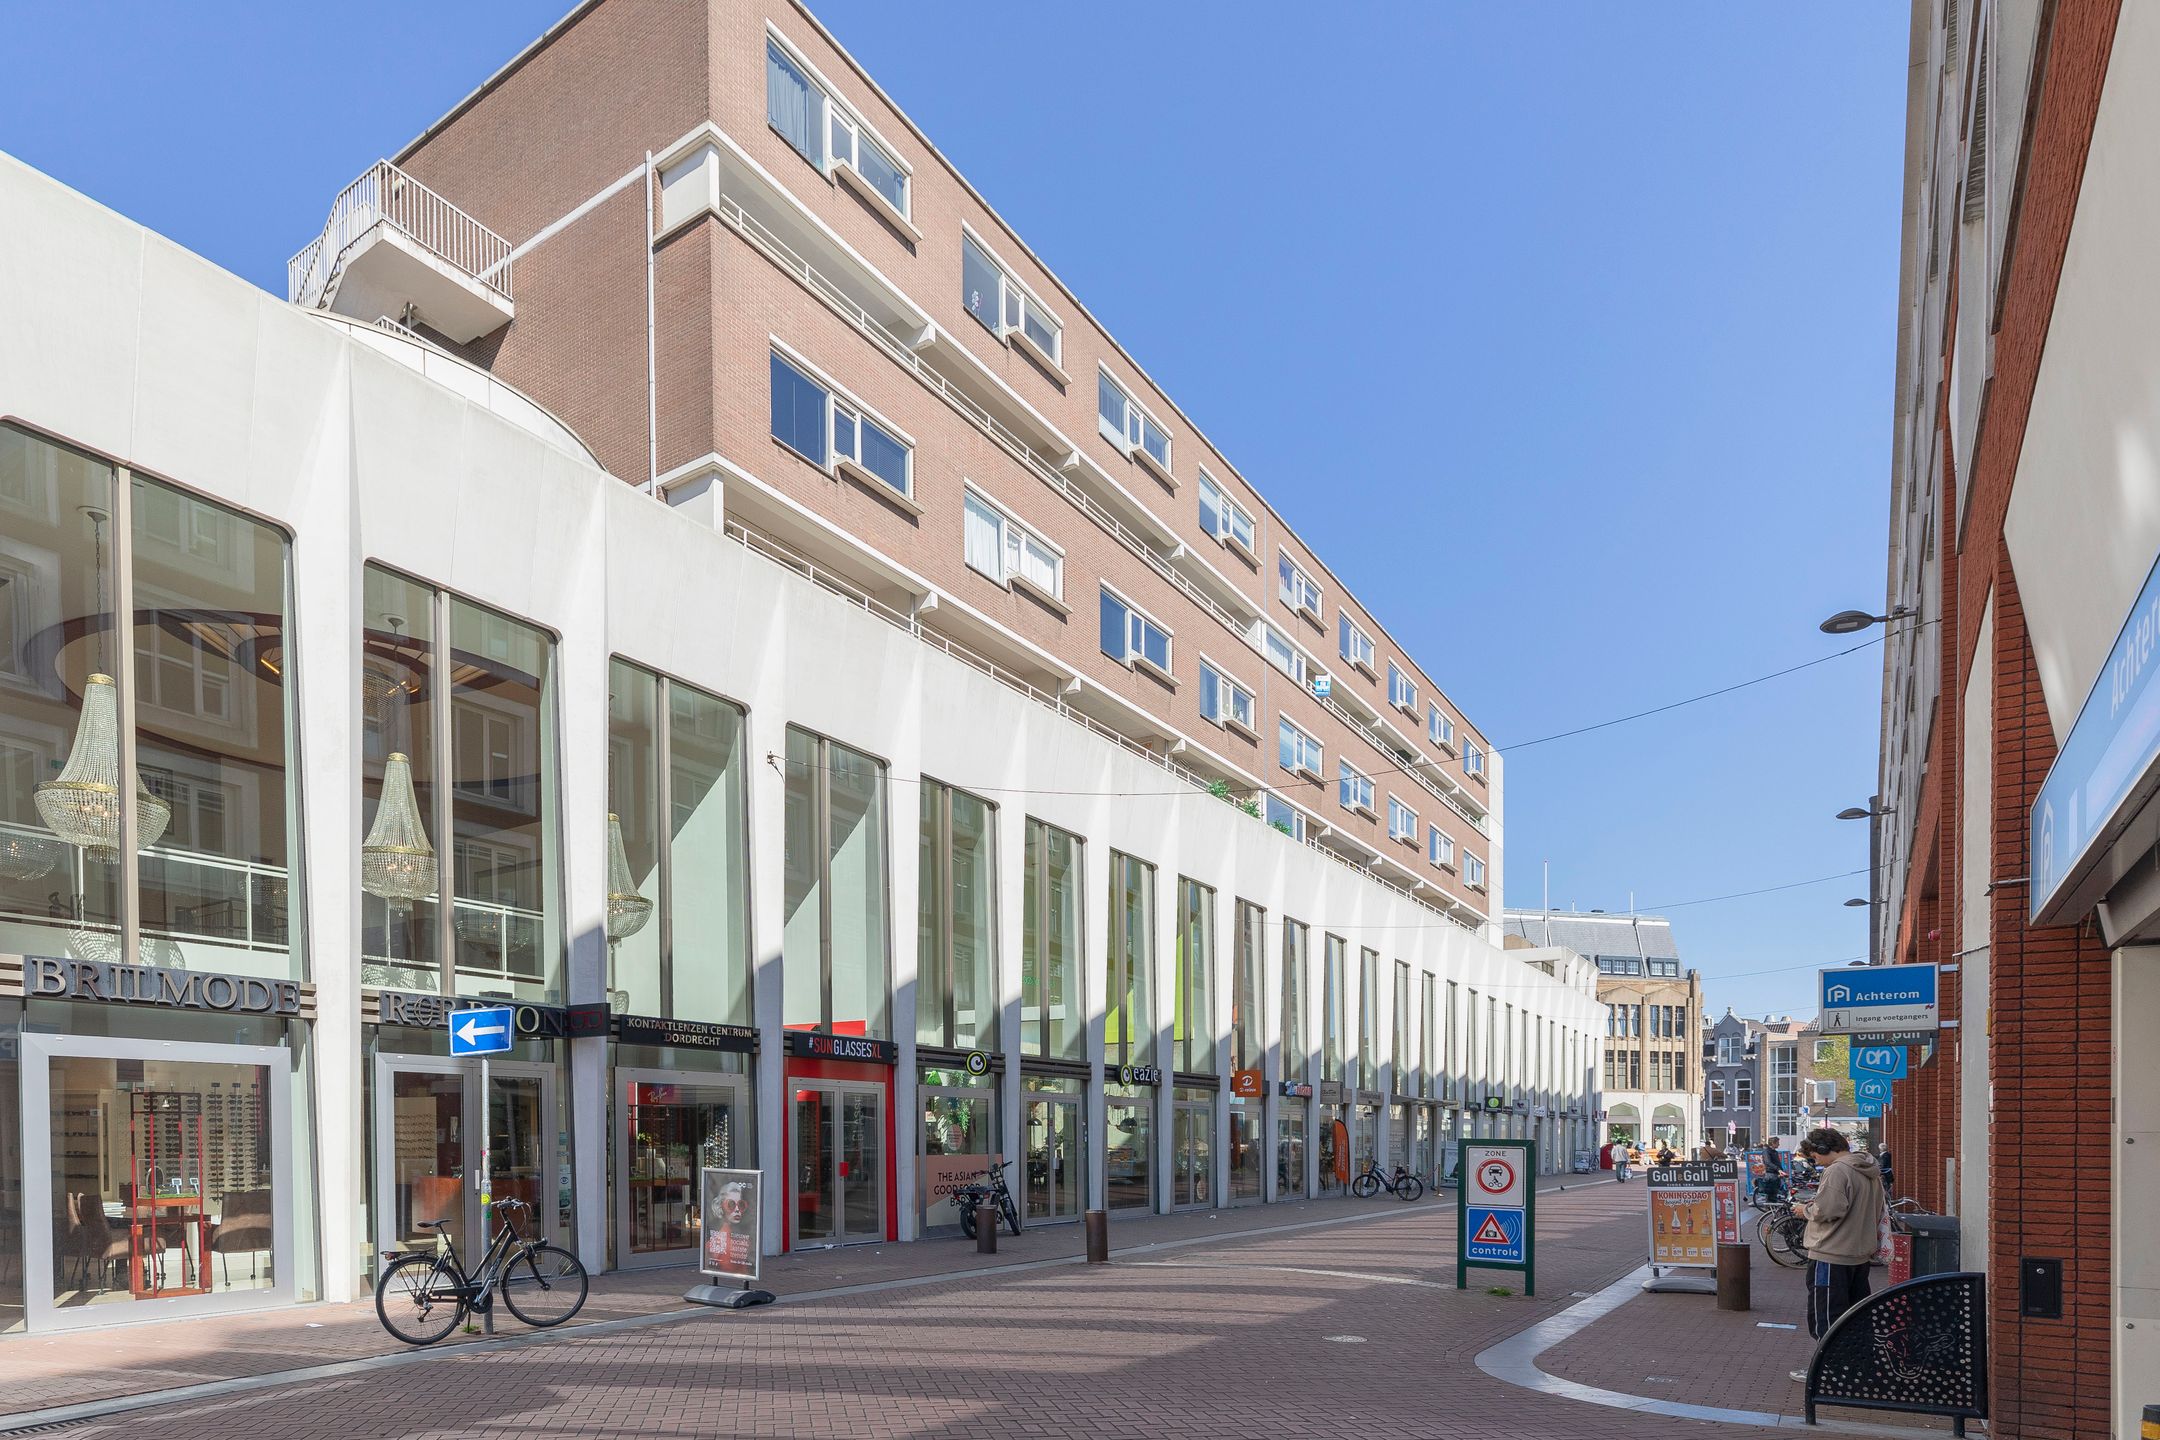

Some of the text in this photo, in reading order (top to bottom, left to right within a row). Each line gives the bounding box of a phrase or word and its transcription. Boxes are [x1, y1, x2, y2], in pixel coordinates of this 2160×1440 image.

[2111, 594, 2160, 721] Achter
[31, 957, 300, 1014] BRILMODE
[1855, 991, 1920, 1001] Achterom
[1855, 1013, 1929, 1023] Ingang voetgangers
[628, 1018, 752, 1038] KONTAKTLENZEN CENTRUM
[665, 1033, 721, 1046] DORDRECHT
[808, 1037, 882, 1059] #SUNGLASSESXL
[1133, 1065, 1159, 1082] eazie
[938, 1172, 953, 1181] THE
[1652, 1170, 1677, 1182] Gall
[1683, 1169, 1709, 1182] Gall
[1657, 1191, 1709, 1200] KONINGSDAG
[1471, 1247, 1519, 1257] controle
